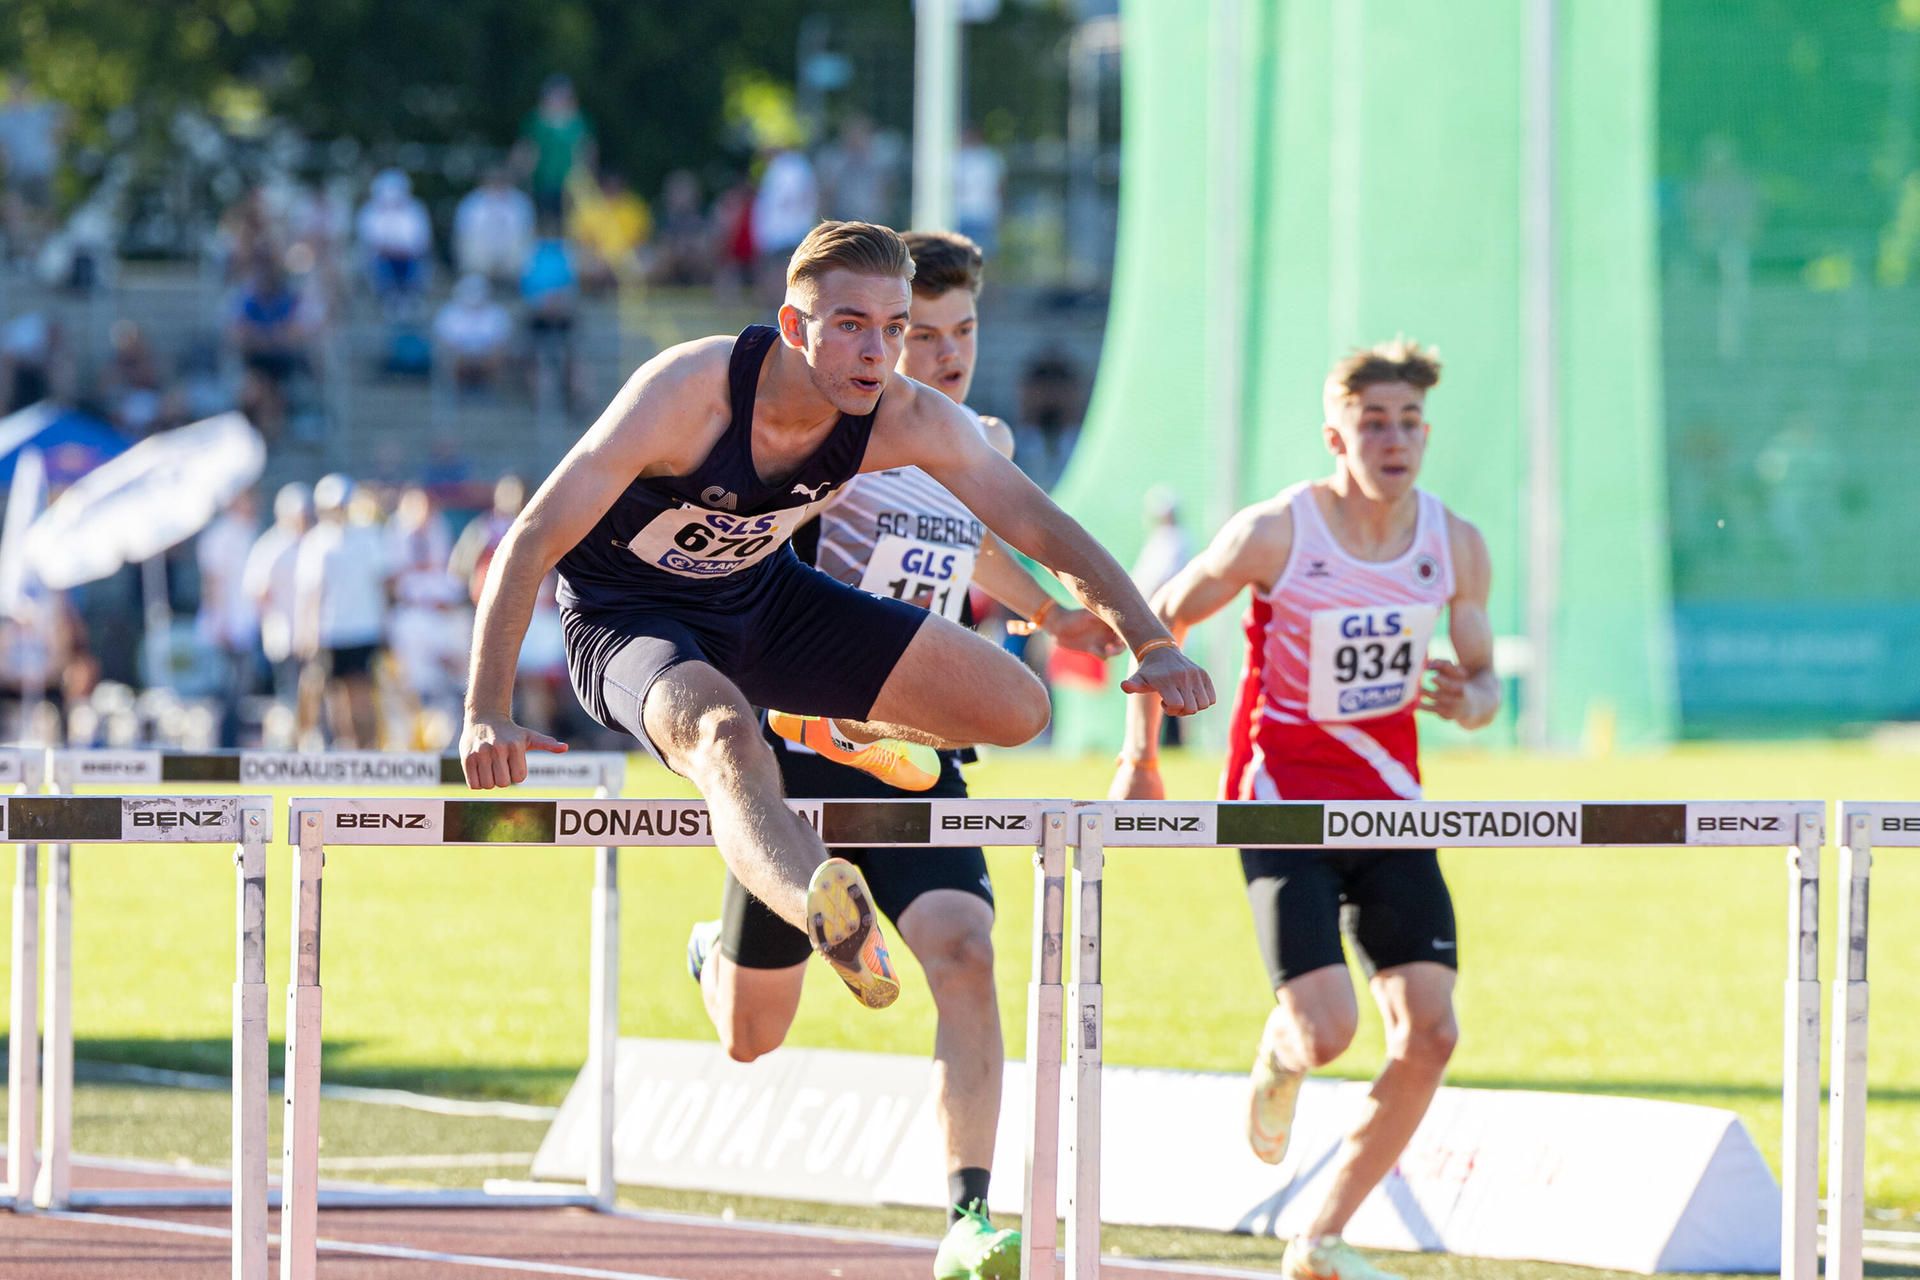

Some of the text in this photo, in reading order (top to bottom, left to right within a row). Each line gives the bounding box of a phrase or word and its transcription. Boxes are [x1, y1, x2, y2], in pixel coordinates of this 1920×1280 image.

[674, 522, 773, 557] 670
[876, 513, 908, 539] SC
[695, 562, 739, 570] PLAN
[1334, 641, 1412, 683] 934
[243, 758, 435, 781] DONAUSTADION
[559, 808, 819, 837] DONAUSTN
[1327, 811, 1577, 837] DONAUSTADION
[613, 1077, 910, 1180] NOVAFON
